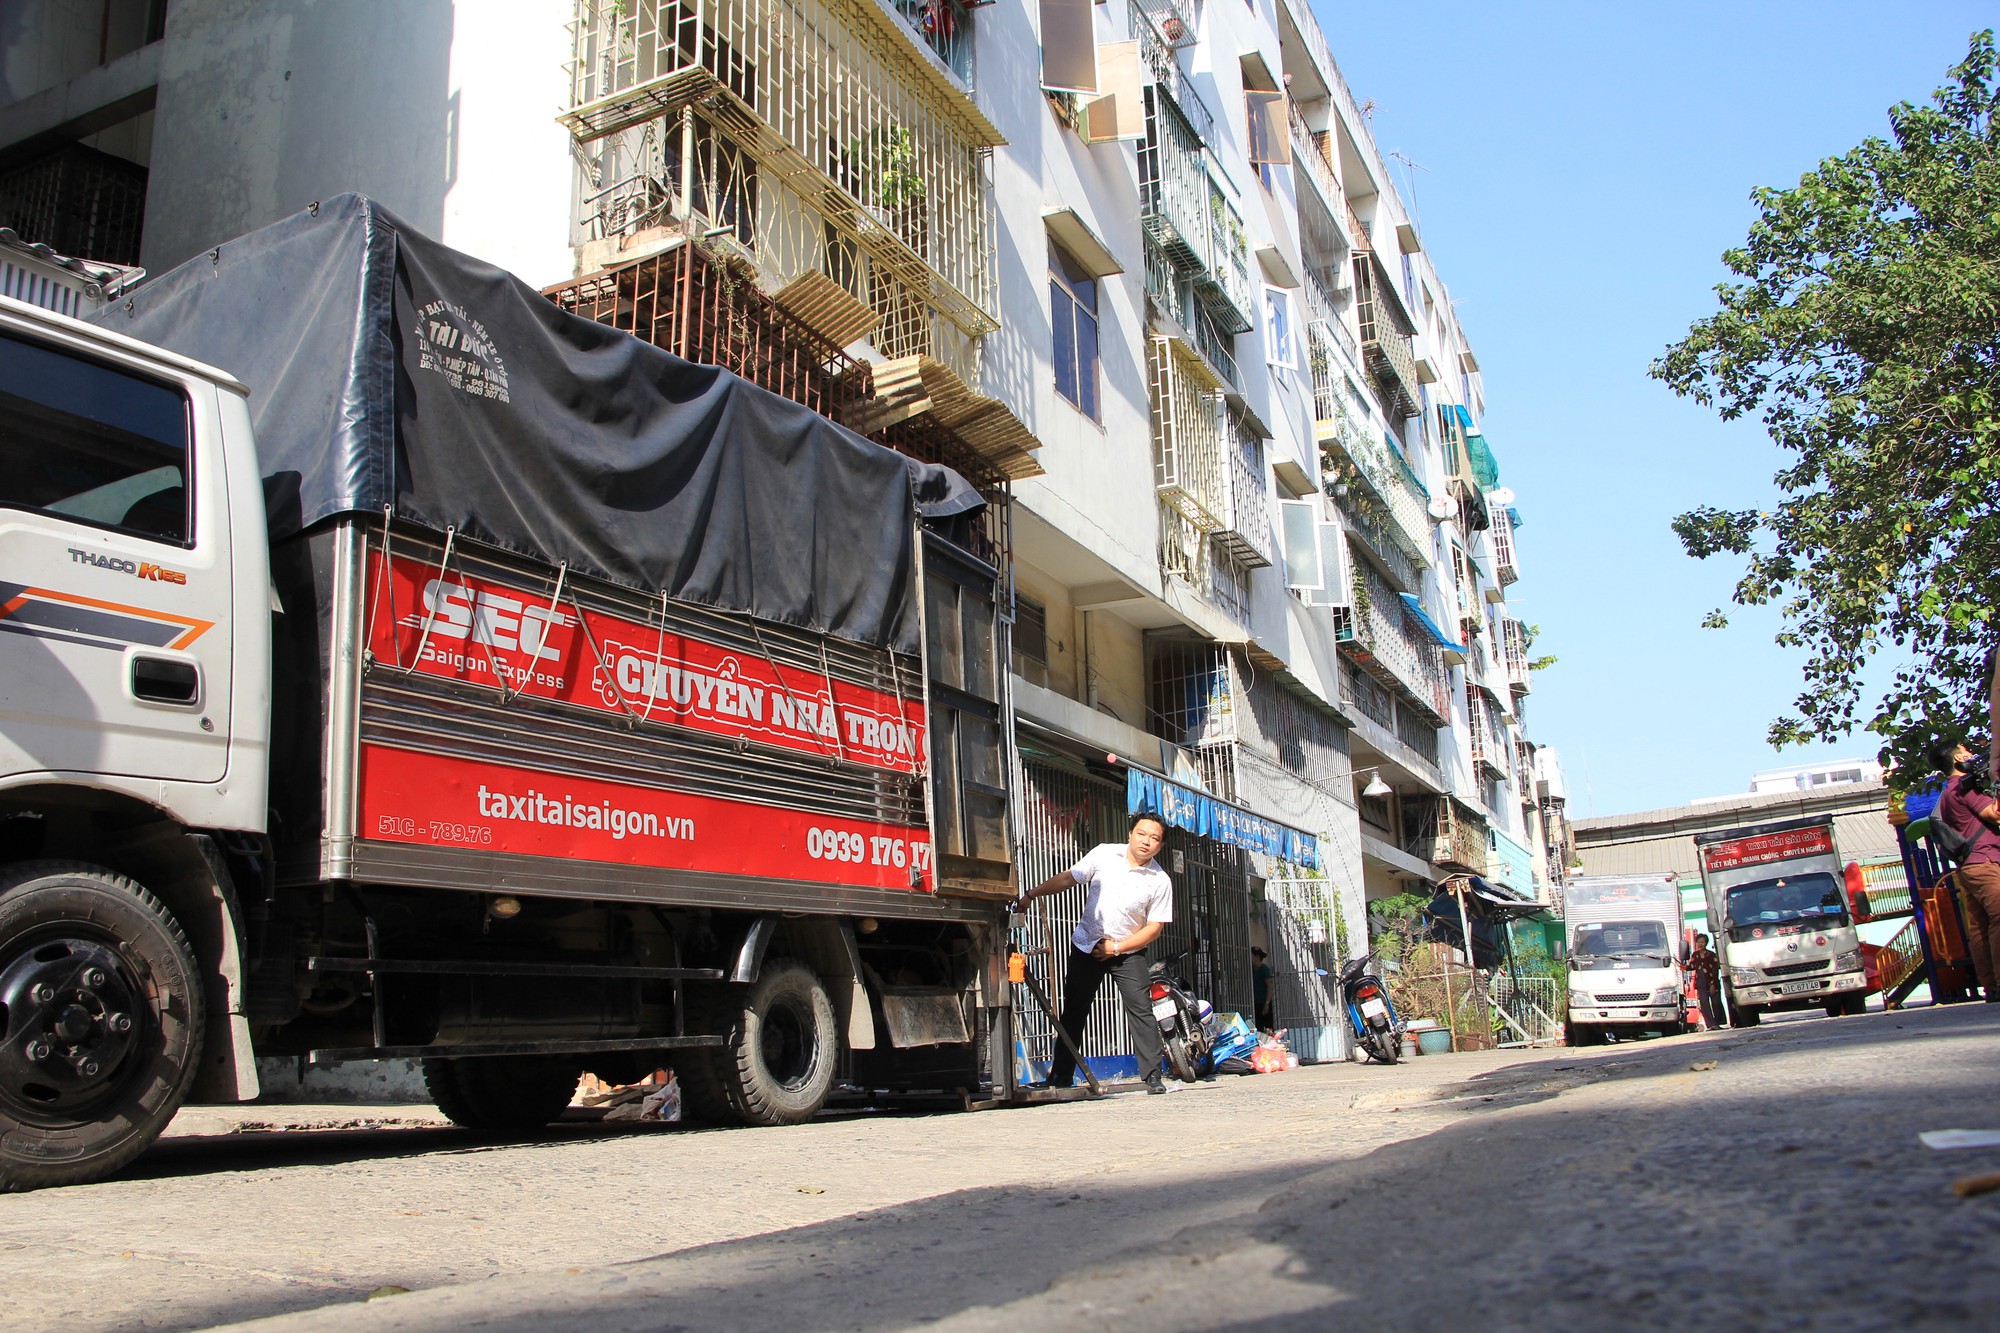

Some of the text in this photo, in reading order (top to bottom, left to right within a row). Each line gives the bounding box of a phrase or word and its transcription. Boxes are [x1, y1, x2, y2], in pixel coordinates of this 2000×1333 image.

[425, 300, 445, 316] BẠT
[429, 320, 459, 349] TÀI
[68, 548, 187, 586] THACO K165
[420, 578, 565, 662] SEC
[419, 641, 565, 690] Saigon Express
[616, 653, 765, 721] CHUYỂN
[771, 690, 838, 736] NHÀ
[844, 710, 917, 763] TRỌN
[378, 815, 415, 836] 51C
[429, 821, 492, 845] 789.76
[477, 785, 695, 841] taxitaisaigon.vn
[807, 827, 865, 863] 0939
[870, 836, 906, 868] 176
[1746, 841, 1767, 851] TAXI
